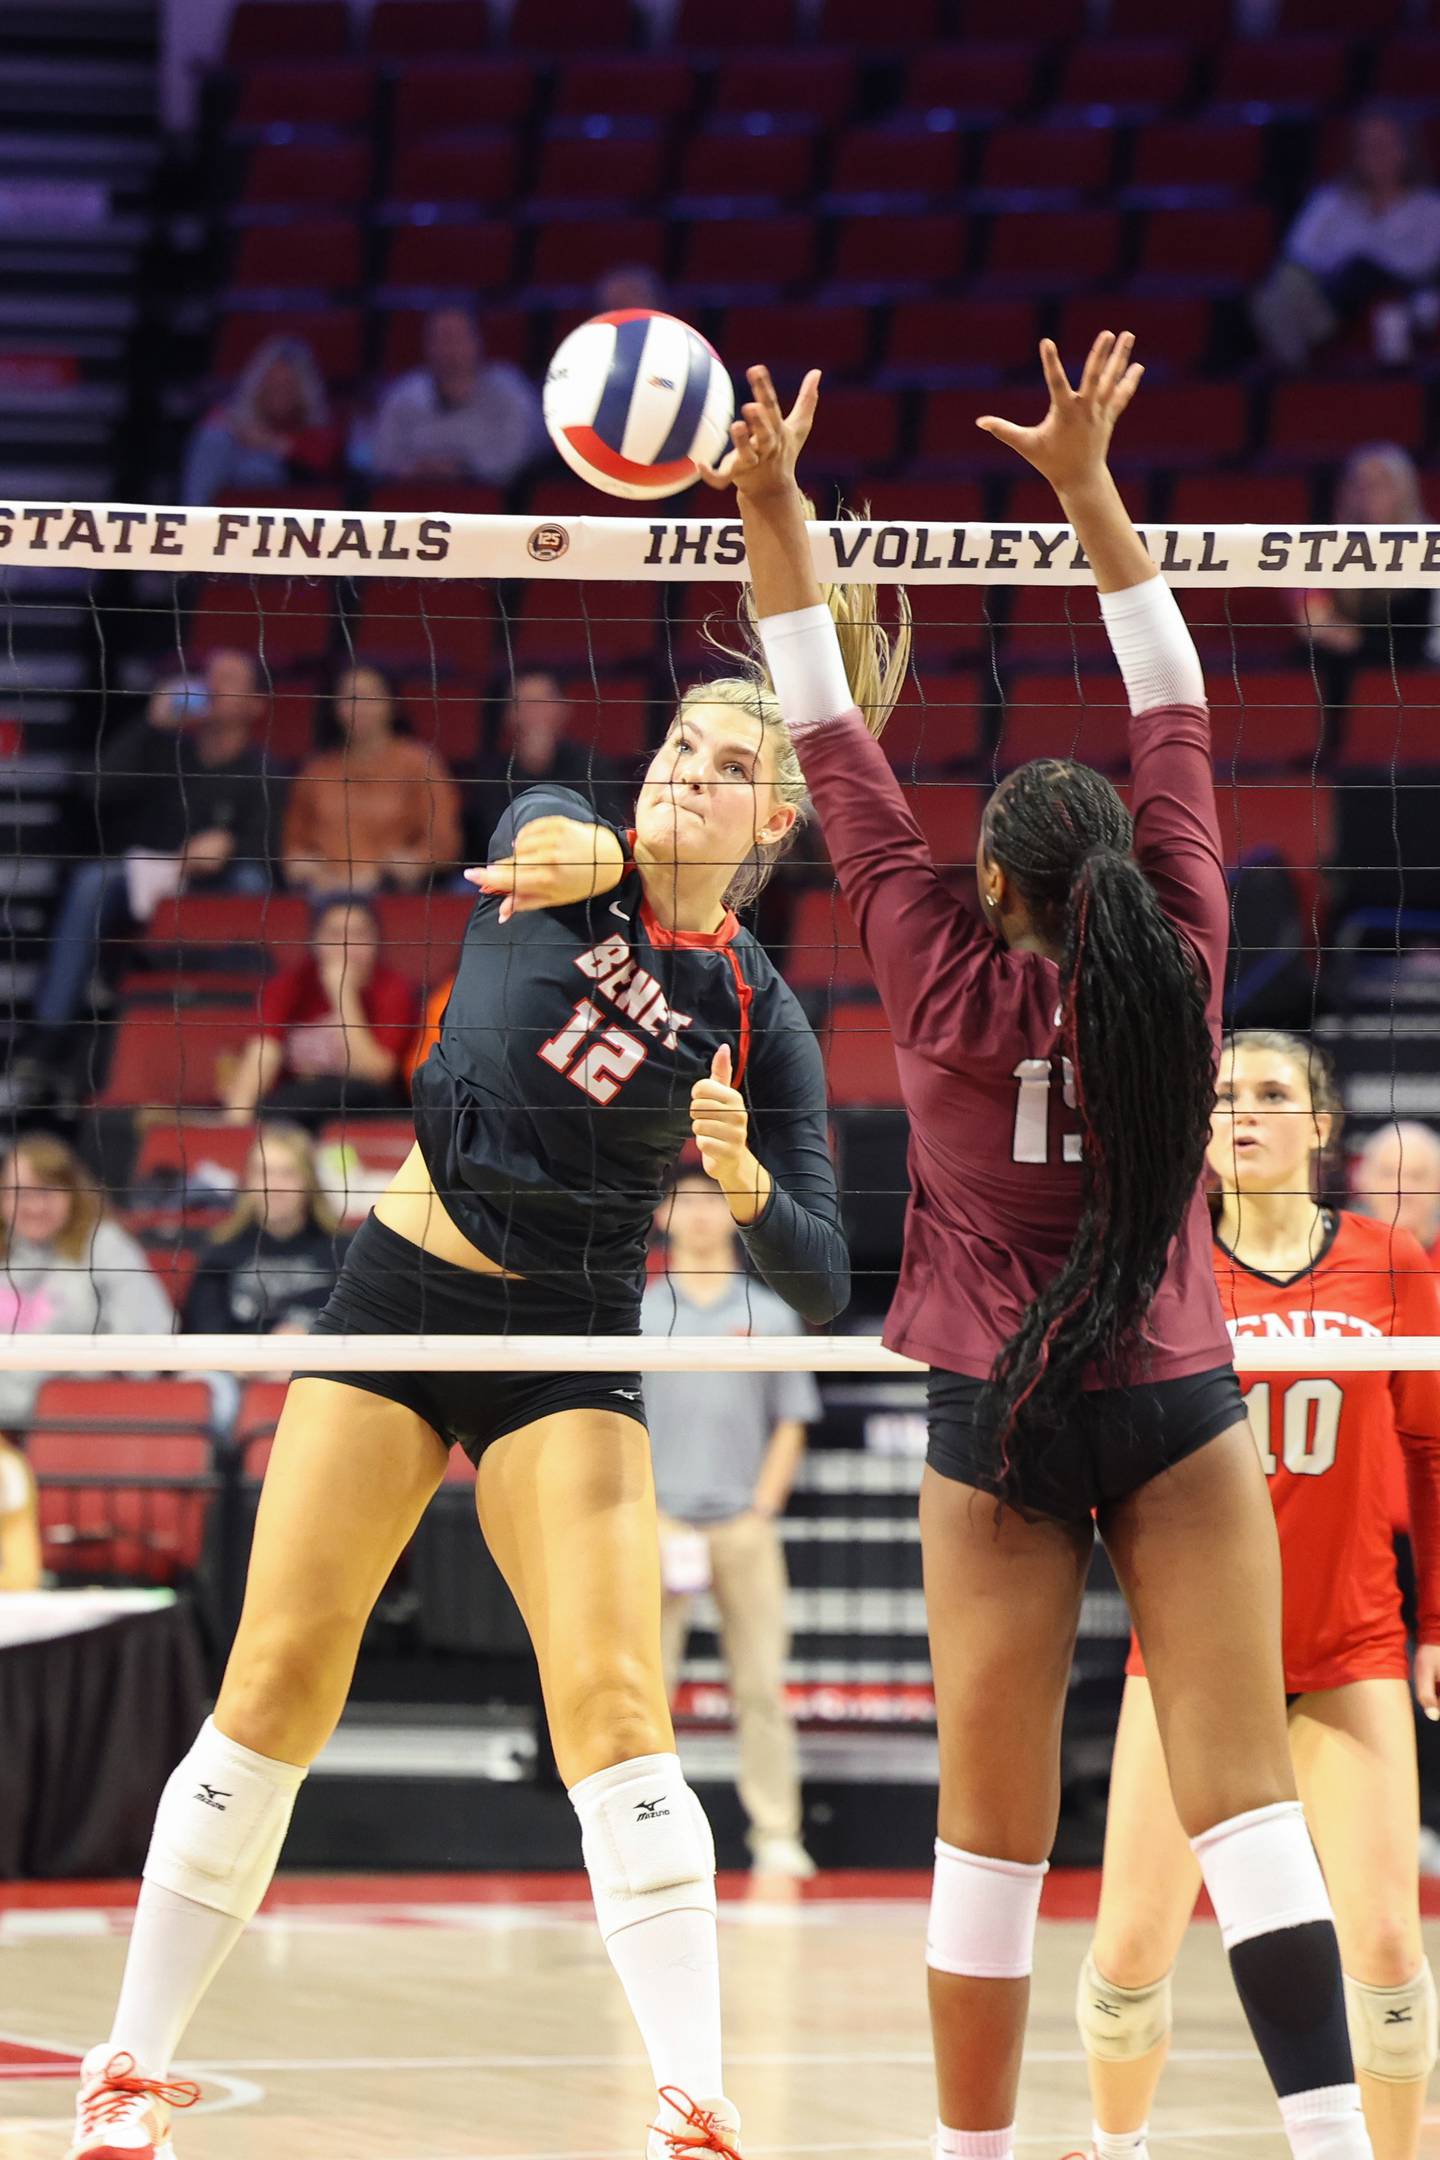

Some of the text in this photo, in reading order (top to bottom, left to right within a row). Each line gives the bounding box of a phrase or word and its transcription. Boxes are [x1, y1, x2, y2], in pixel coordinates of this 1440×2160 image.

[213, 514, 451, 561] FINALS
[644, 525, 748, 565] IHS
[829, 526, 1229, 571] VOLLEYLL
[536, 997, 648, 1106] 12
[1013, 1055, 1084, 1163] 1
[1241, 1378, 1344, 1476] 10
